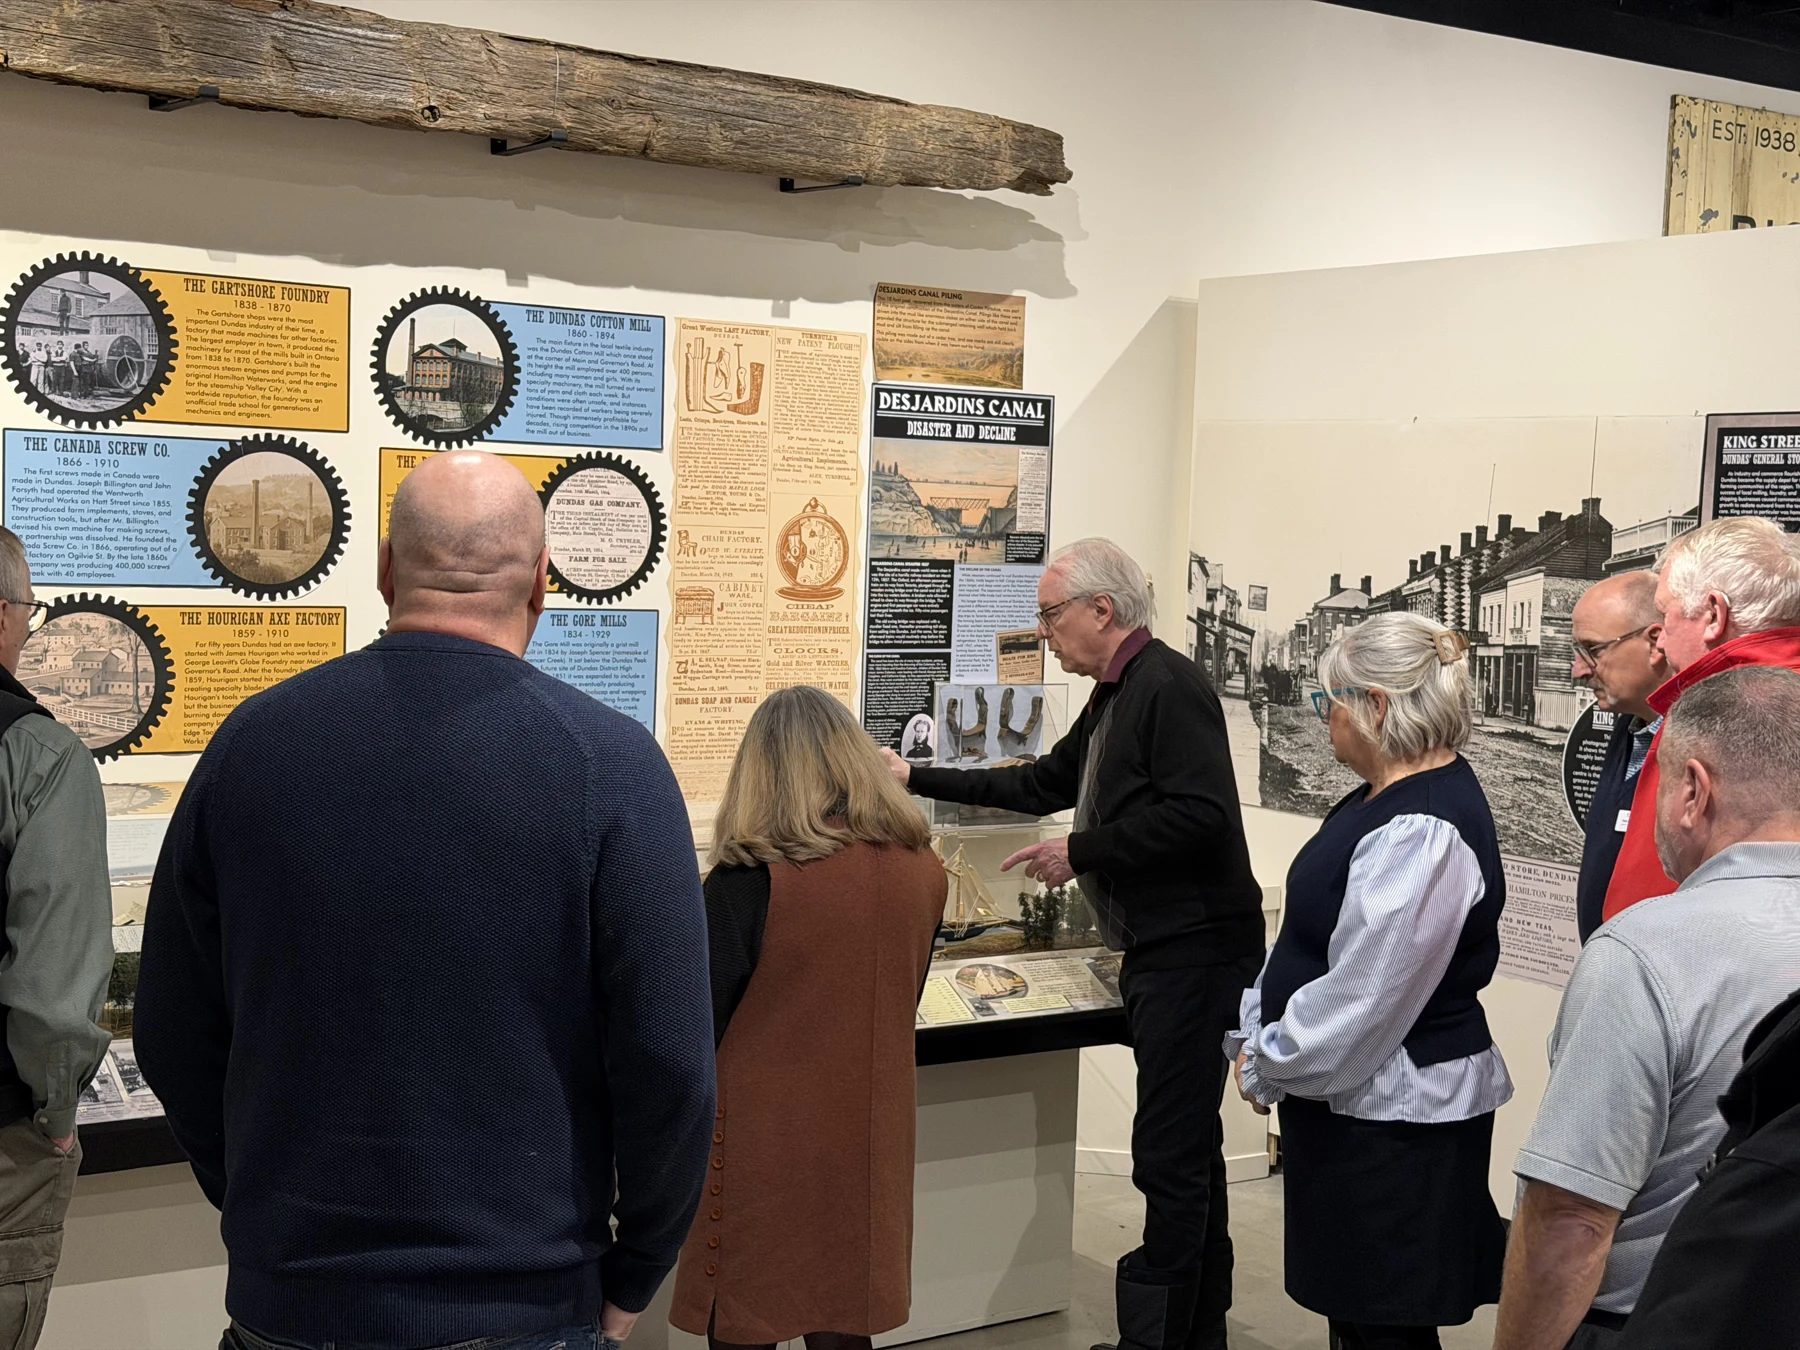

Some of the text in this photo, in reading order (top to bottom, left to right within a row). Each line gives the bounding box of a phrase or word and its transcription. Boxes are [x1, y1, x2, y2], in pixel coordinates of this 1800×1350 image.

[1755, 127, 1796, 152] 1938
[184, 278, 330, 304] THE GARTSHORE FOUNDRY
[878, 286, 962, 300] DESJARDINS CANAL PILING
[234, 300, 257, 310] 1838
[268, 303, 291, 312] 1870
[211, 311, 244, 319] Gartshore
[526, 310, 651, 332] THE DUNDAS COTTON MILL
[567, 329, 587, 338] 1860
[596, 331, 615, 340] 1894
[741, 328, 771, 337] FACTORY,
[801, 333, 837, 341] TURNBULL'S
[633, 345, 654, 353] industry
[777, 337, 860, 351] NEW PATENT PLOUGH!!!
[879, 392, 1045, 418] DESJARDINS CANAL
[907, 421, 1016, 441] DISASTER AND DECLINE
[24, 437, 170, 457] THE CANADA SCREW CO.
[1723, 436, 1757, 448] KING
[57, 457, 82, 467] 1866
[95, 459, 119, 468] 1910
[397, 455, 416, 468] THE
[1722, 454, 1751, 464] DUNDAS'
[1753, 454, 1784, 464] GENERAL
[104, 481, 137, 489] Billington
[719, 583, 764, 592] CABINET
[180, 612, 341, 625] THE HOURIGAN AXE FACTORY
[550, 614, 627, 627] THE GORE MILLS
[1593, 711, 1614, 725] KING
[1511, 864, 1576, 882] STORE, DUNDAS
[1509, 884, 1575, 904] HAMILTON PRICES
